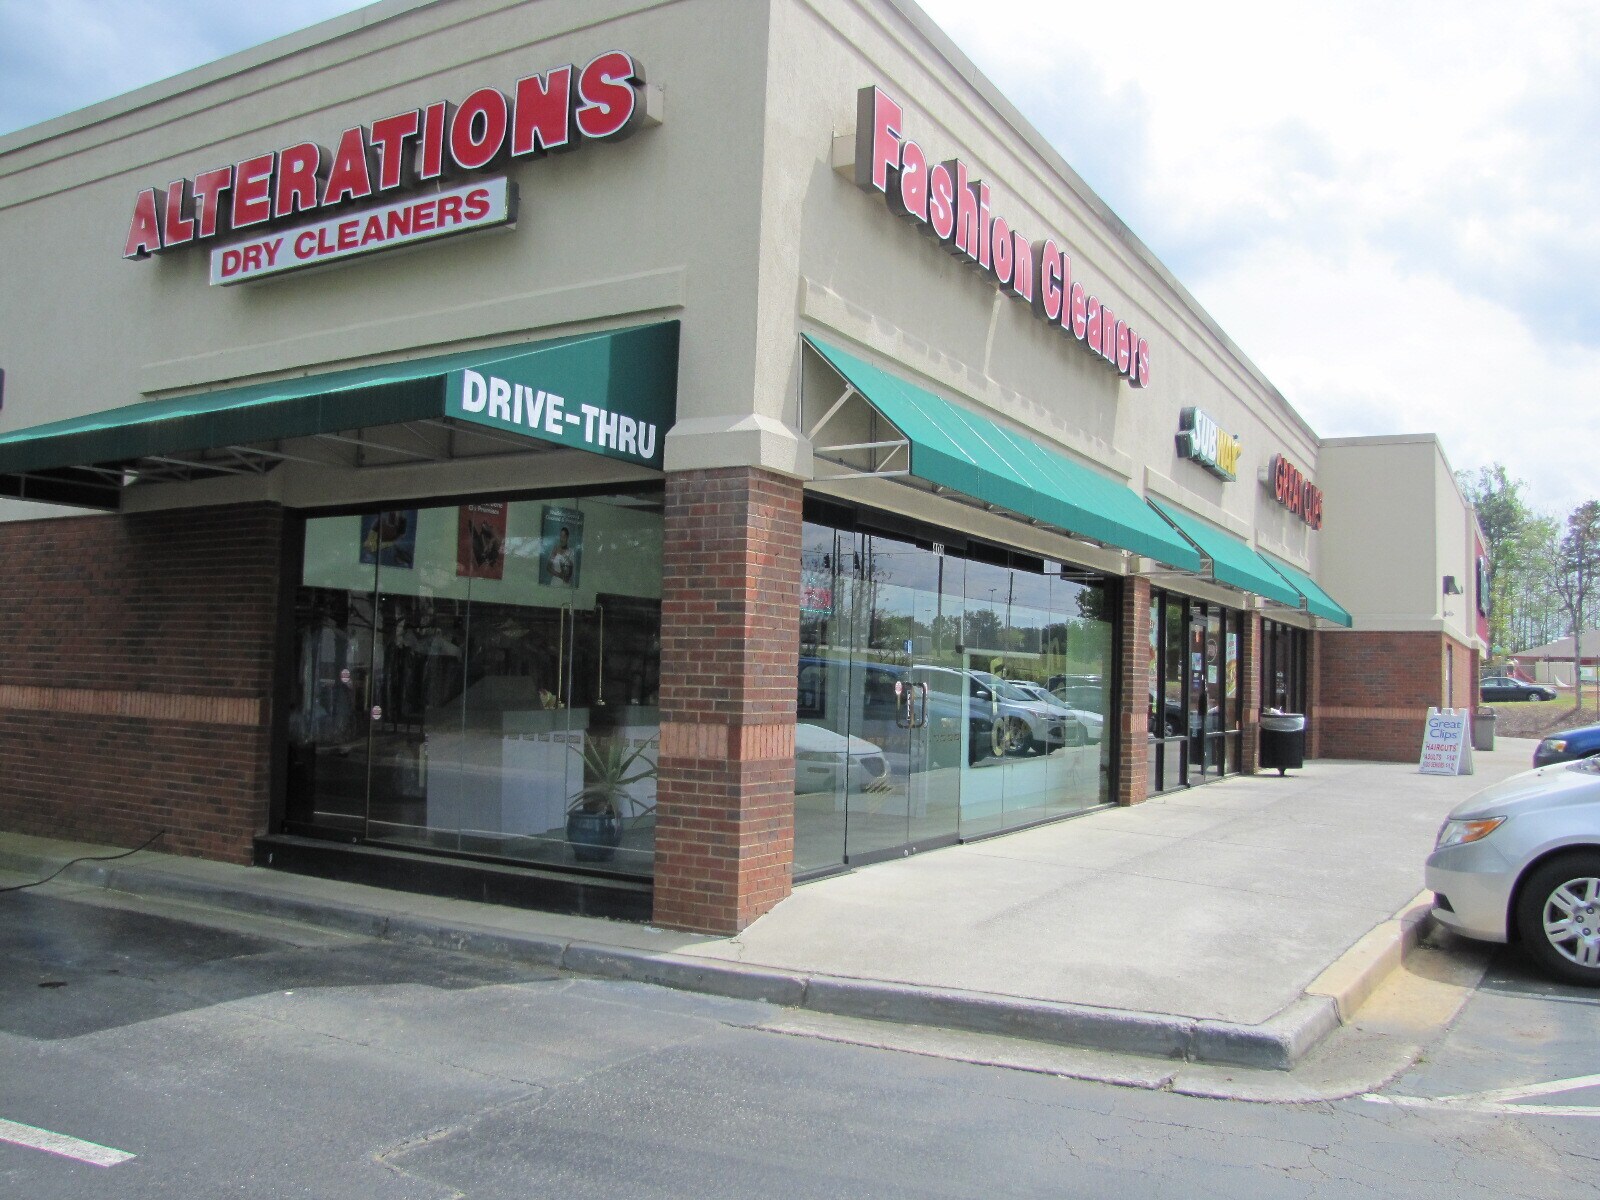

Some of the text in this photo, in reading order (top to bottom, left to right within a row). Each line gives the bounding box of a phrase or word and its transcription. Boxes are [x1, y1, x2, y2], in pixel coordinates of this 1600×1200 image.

[123, 50, 638, 260] ALTERATIONS
[220, 188, 491, 278] DRY CLEANERS
[873, 85, 1150, 389] Fashion Cleaners
[462, 368, 657, 459] DRIVE-THRU
[1425, 744, 1457, 752] HAIRCUTS
[1428, 718, 1461, 729] Great
[1430, 728, 1457, 741] Clips
